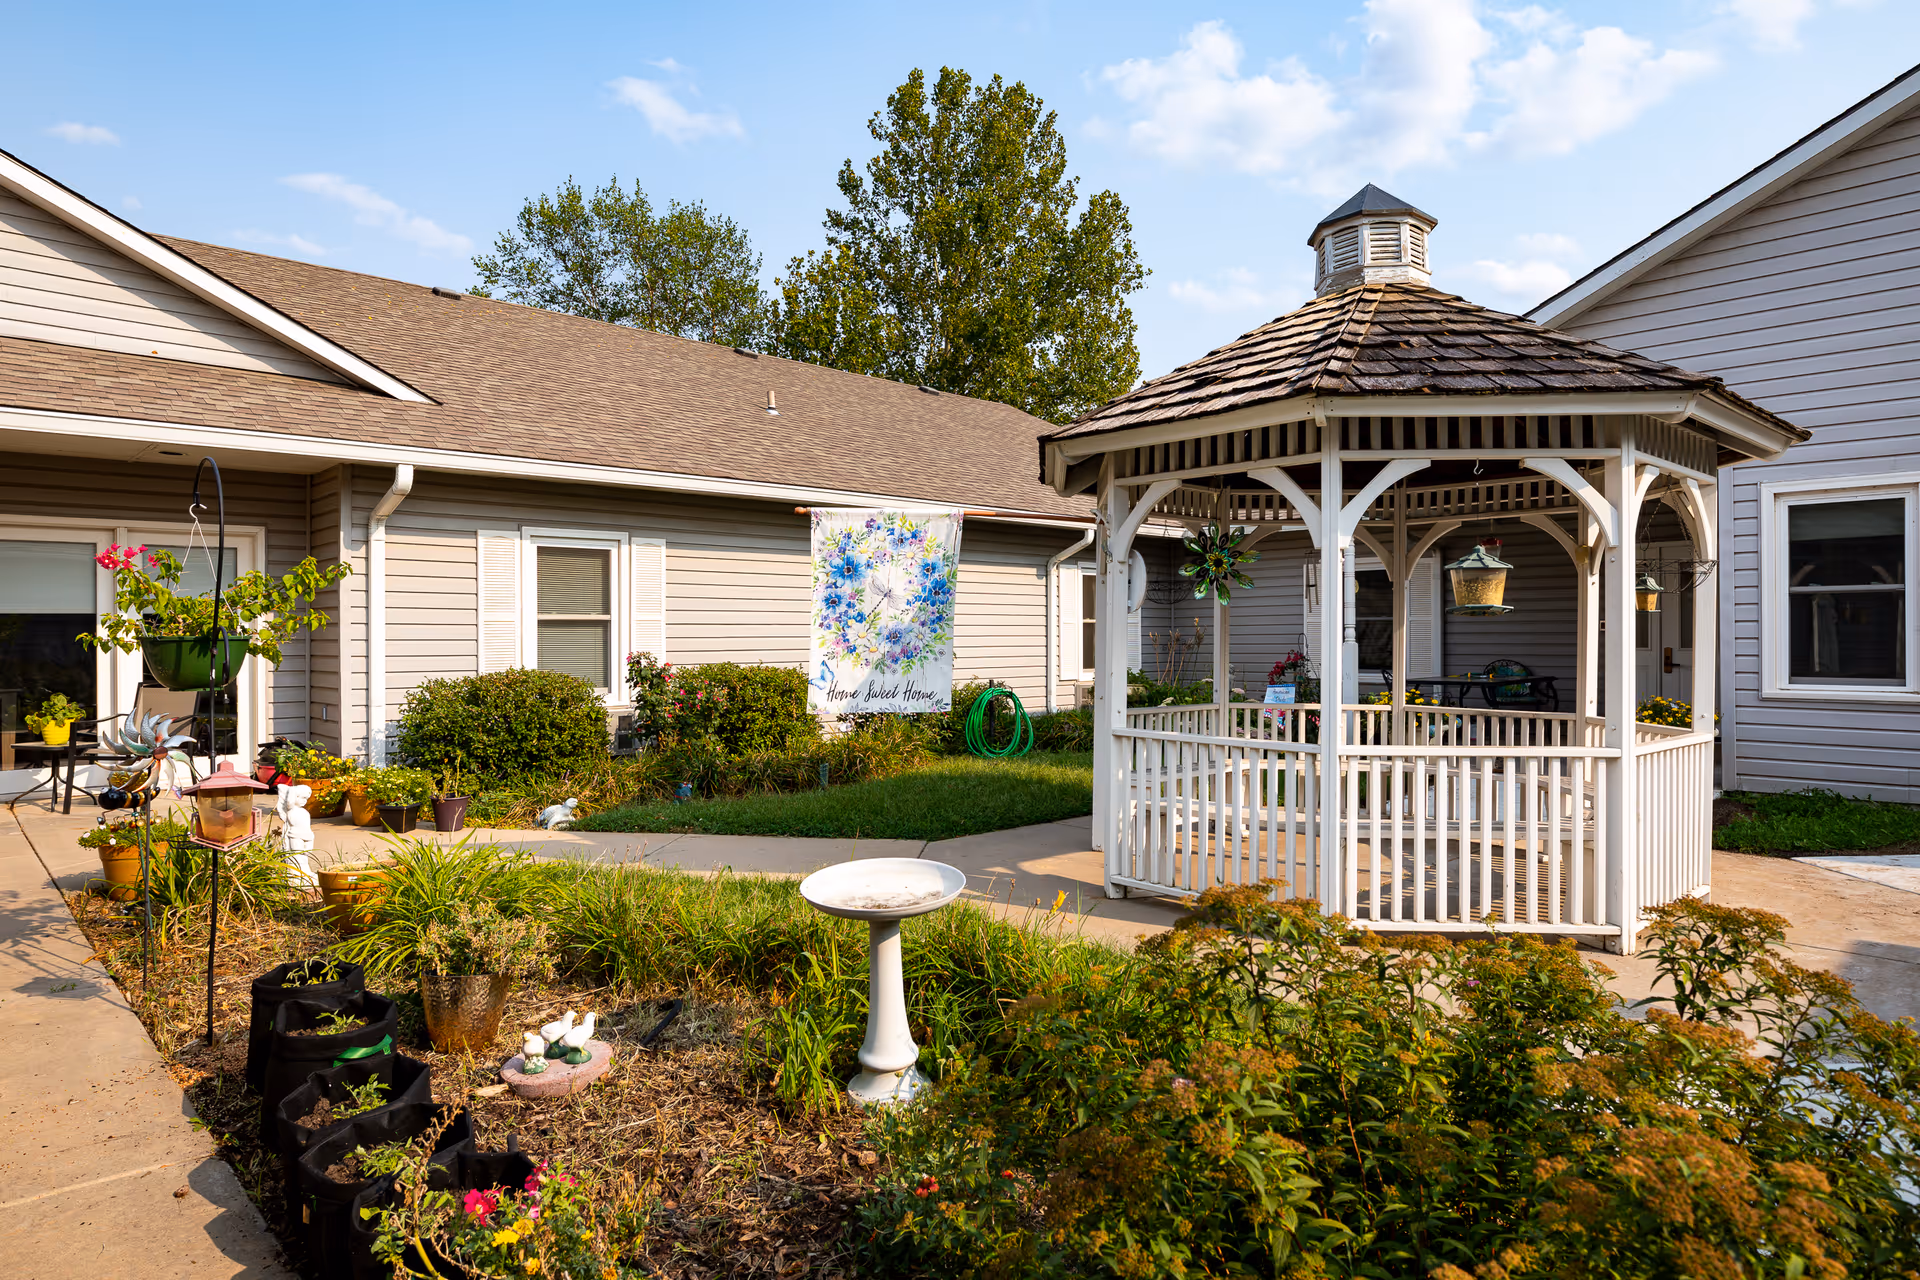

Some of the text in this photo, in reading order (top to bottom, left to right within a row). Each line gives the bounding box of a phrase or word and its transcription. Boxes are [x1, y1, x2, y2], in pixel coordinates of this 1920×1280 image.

[826, 680, 938, 702] Home Sweet Home
